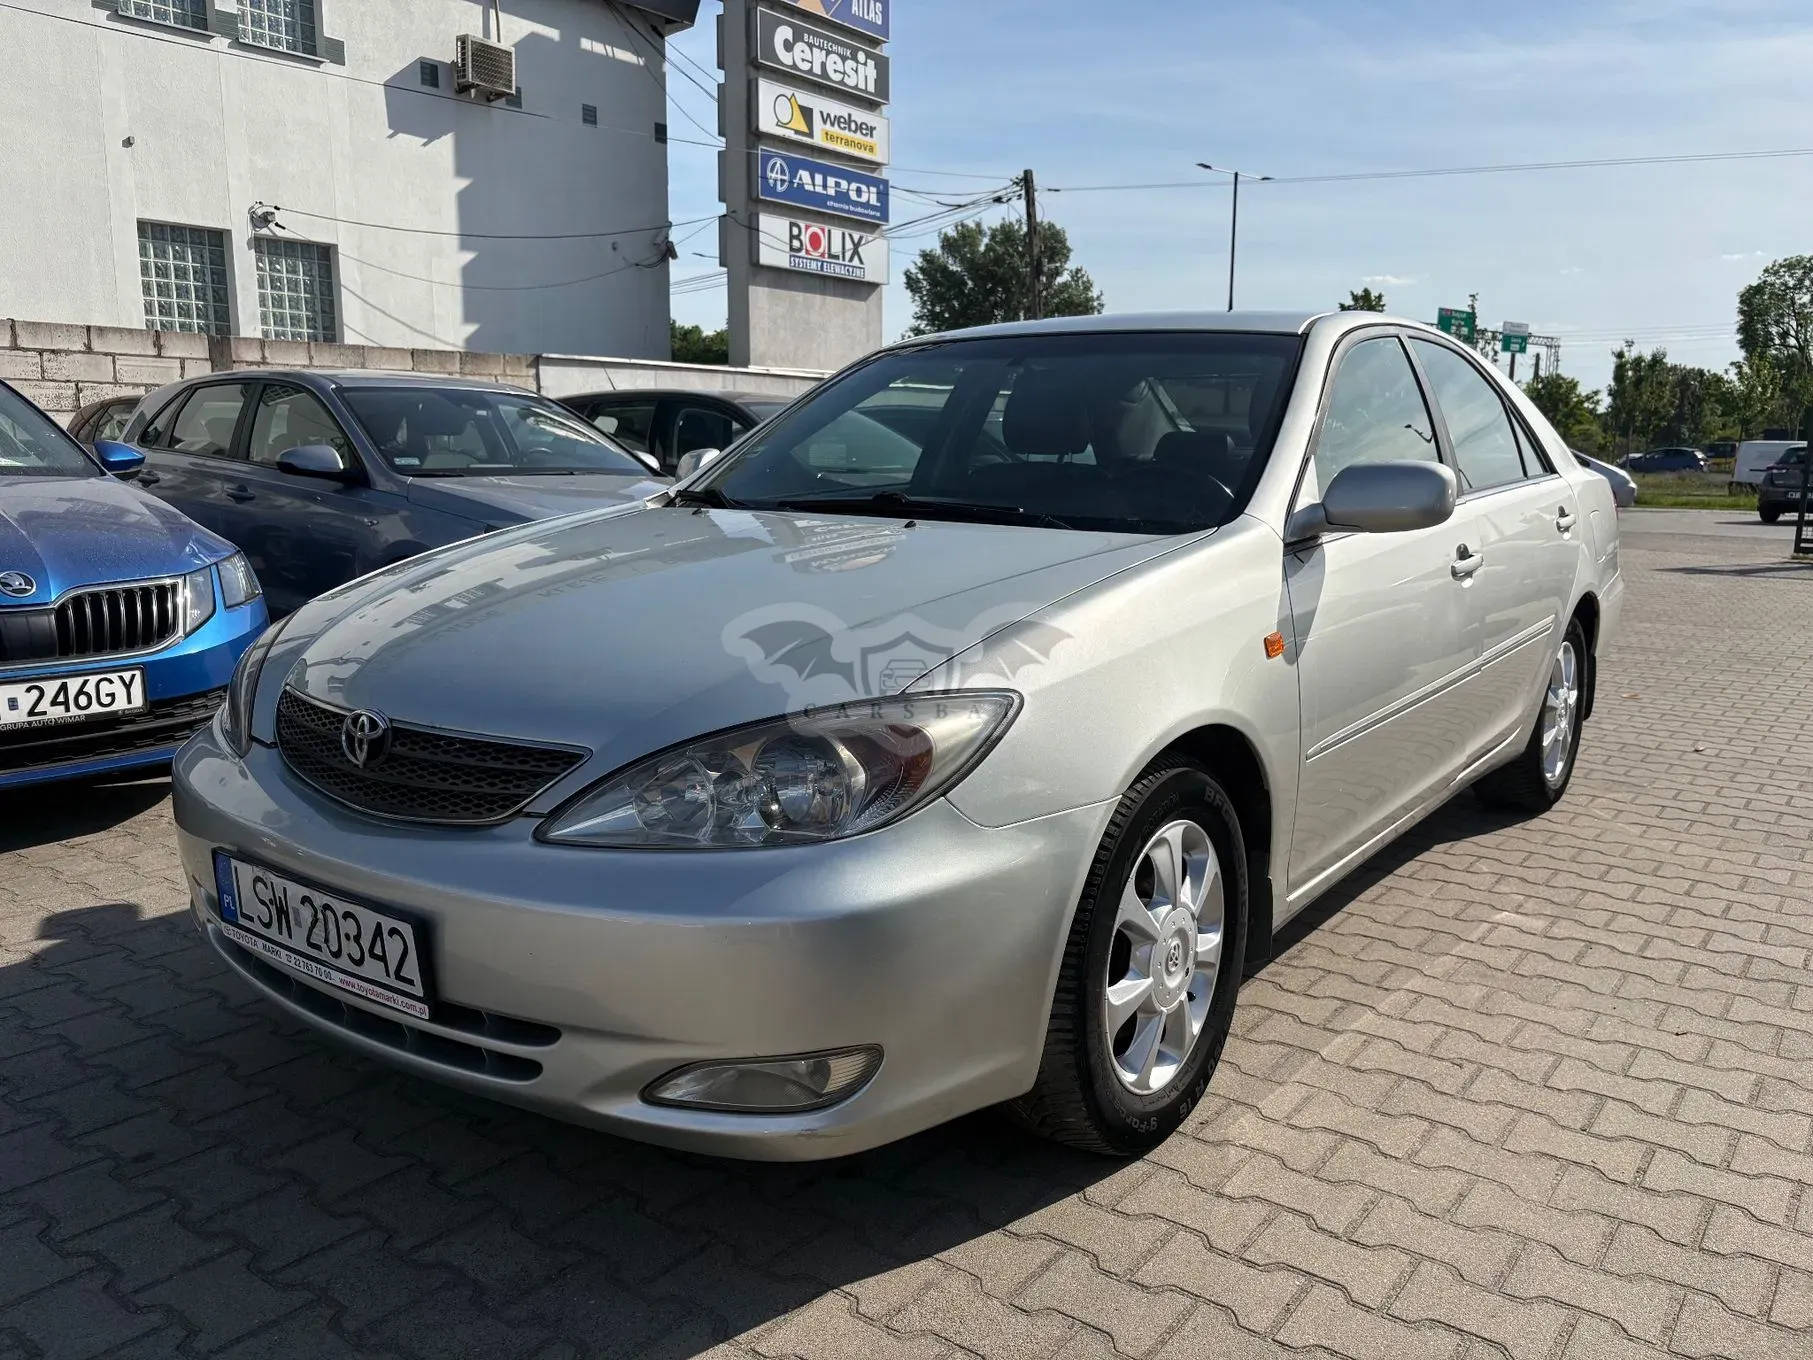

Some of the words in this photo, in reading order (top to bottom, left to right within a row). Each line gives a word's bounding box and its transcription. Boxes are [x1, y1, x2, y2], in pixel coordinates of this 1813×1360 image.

[851, 0, 882, 25] ATLAS
[774, 25, 877, 93] Ceresit
[803, 33, 852, 58] BAUTECHNIK
[819, 110, 876, 139] weber
[824, 132, 875, 154] terranova
[793, 169, 881, 206] ALPOL
[789, 221, 865, 265] BOLIX
[790, 258, 822, 273] SYSTEMY
[823, 263, 865, 279] ELEWACYJNE
[24, 673, 137, 717] 246GY
[0, 722, 29, 731] GRUPA
[56, 715, 86, 725] WIMAR
[223, 894, 235, 910] PL
[233, 866, 293, 939] LSW
[300, 895, 416, 987] 20342
[231, 929, 259, 949] TOYOTA
[338, 977, 428, 1017] www.toyotamarki.com.pl
